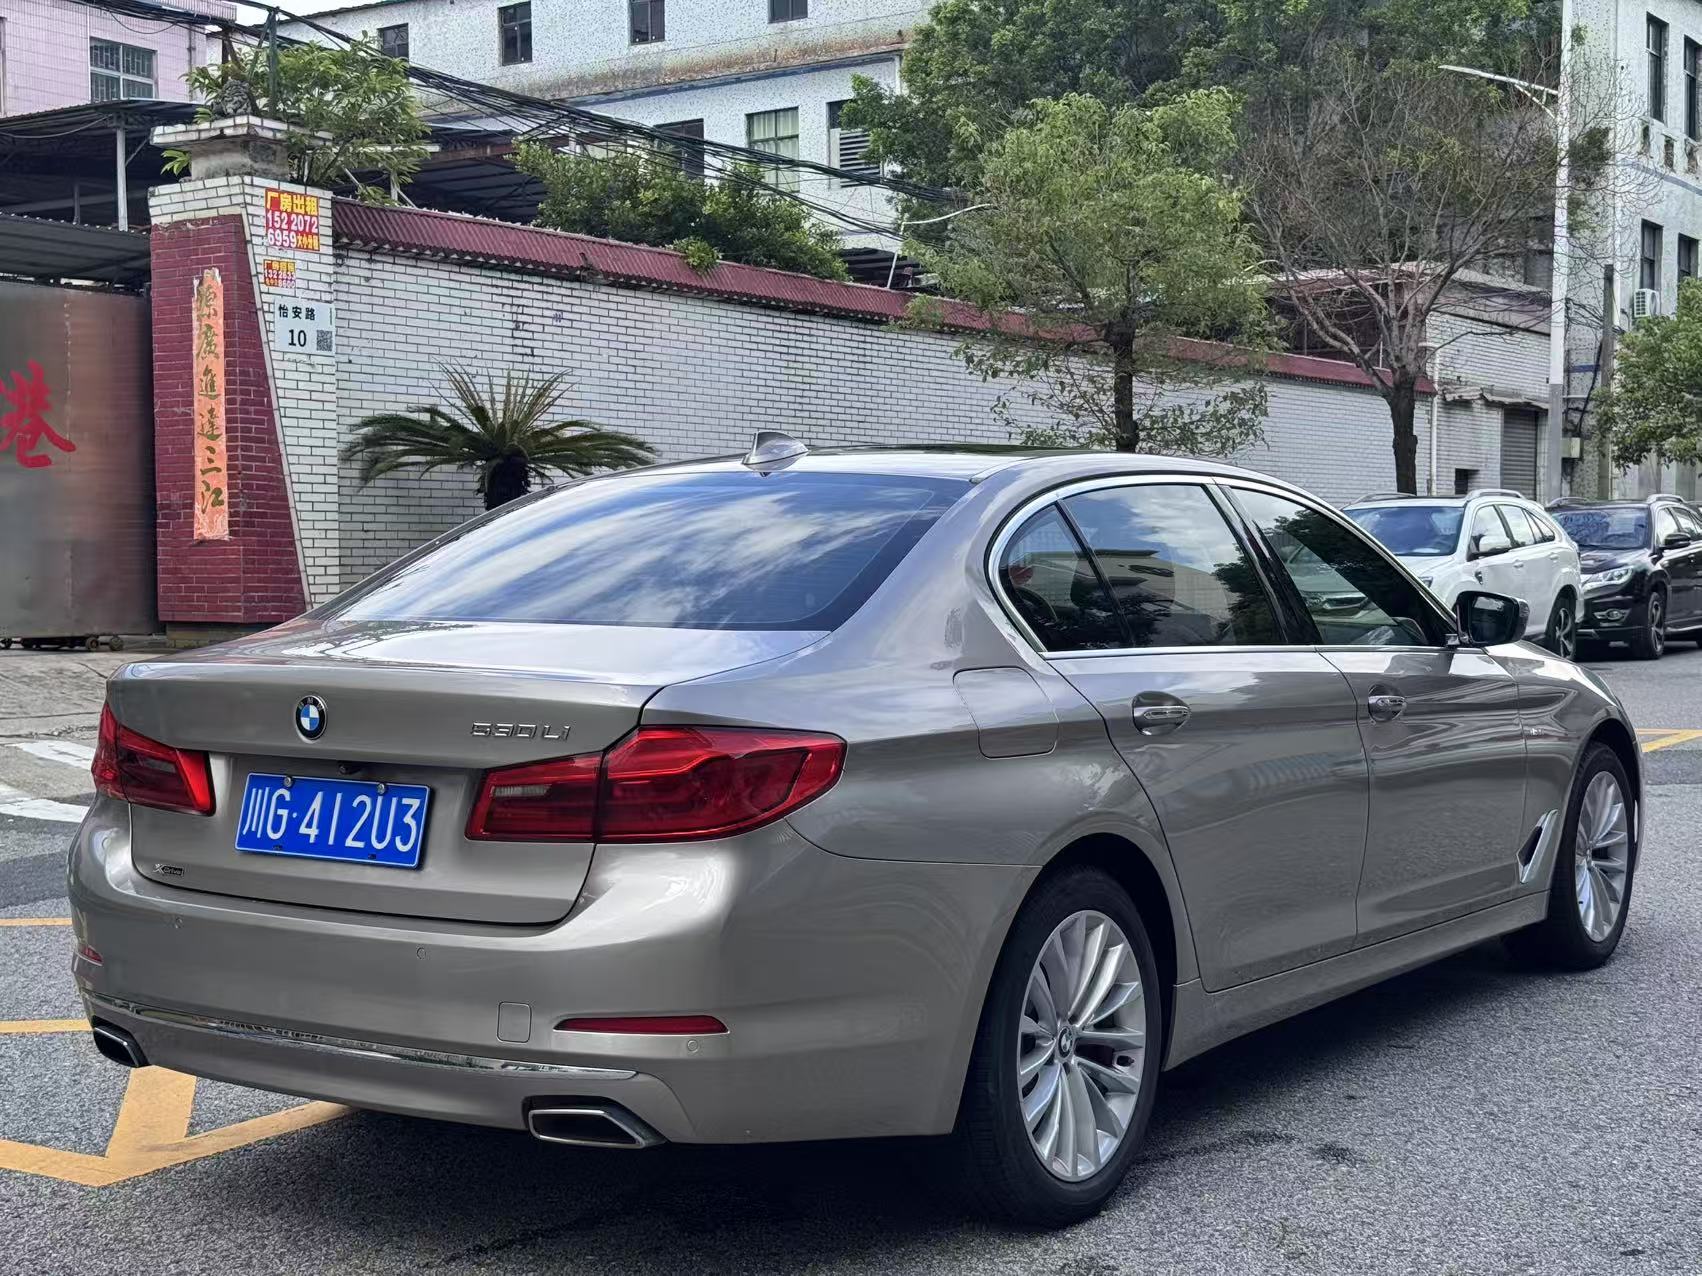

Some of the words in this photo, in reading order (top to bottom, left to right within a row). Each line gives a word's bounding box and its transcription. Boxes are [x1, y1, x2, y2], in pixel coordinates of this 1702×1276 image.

[266, 191, 318, 216] 厂房出租
[267, 210, 288, 229] 152
[290, 213, 318, 234] 2072
[268, 228, 297, 248] 6959
[278, 303, 315, 321] 怡安路
[288, 329, 307, 347] 10
[242, 786, 421, 853] 川G·412U3
